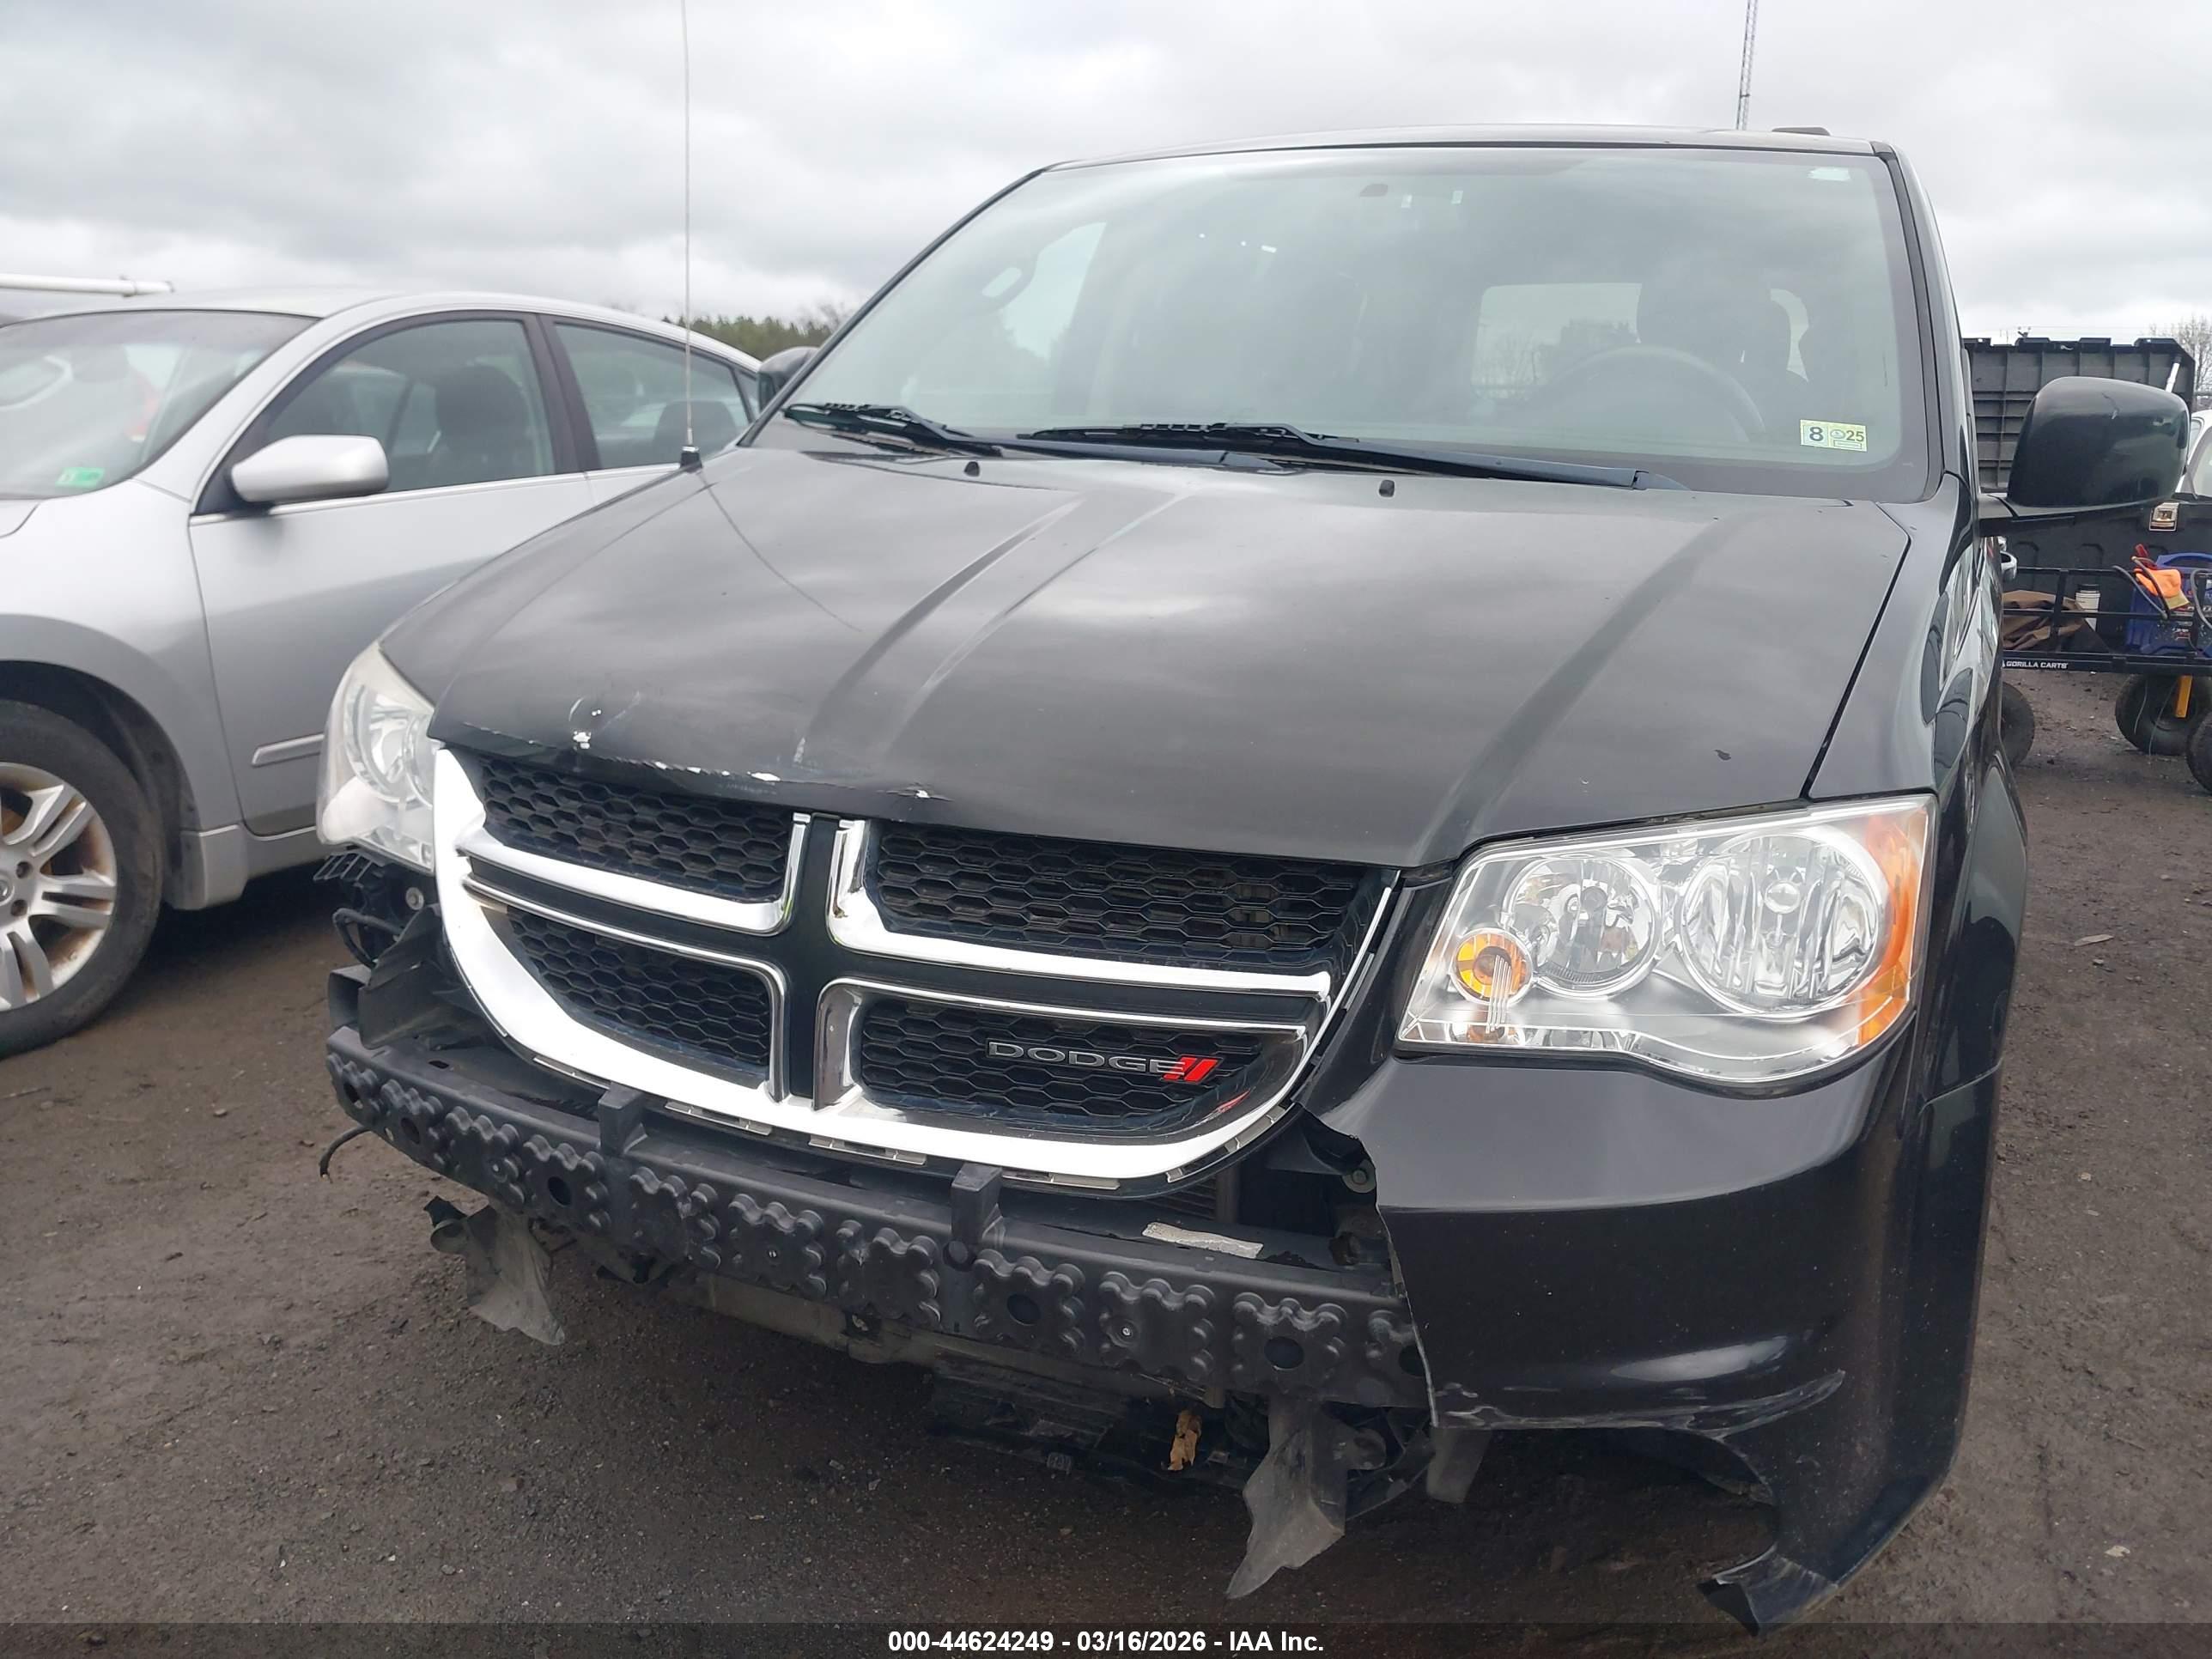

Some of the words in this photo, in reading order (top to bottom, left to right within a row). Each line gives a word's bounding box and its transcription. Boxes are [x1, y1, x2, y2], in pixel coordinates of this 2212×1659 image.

[1809, 427, 1824, 441] 8
[1846, 430, 1864, 441] 25
[988, 1042, 1185, 1075] DODGE
